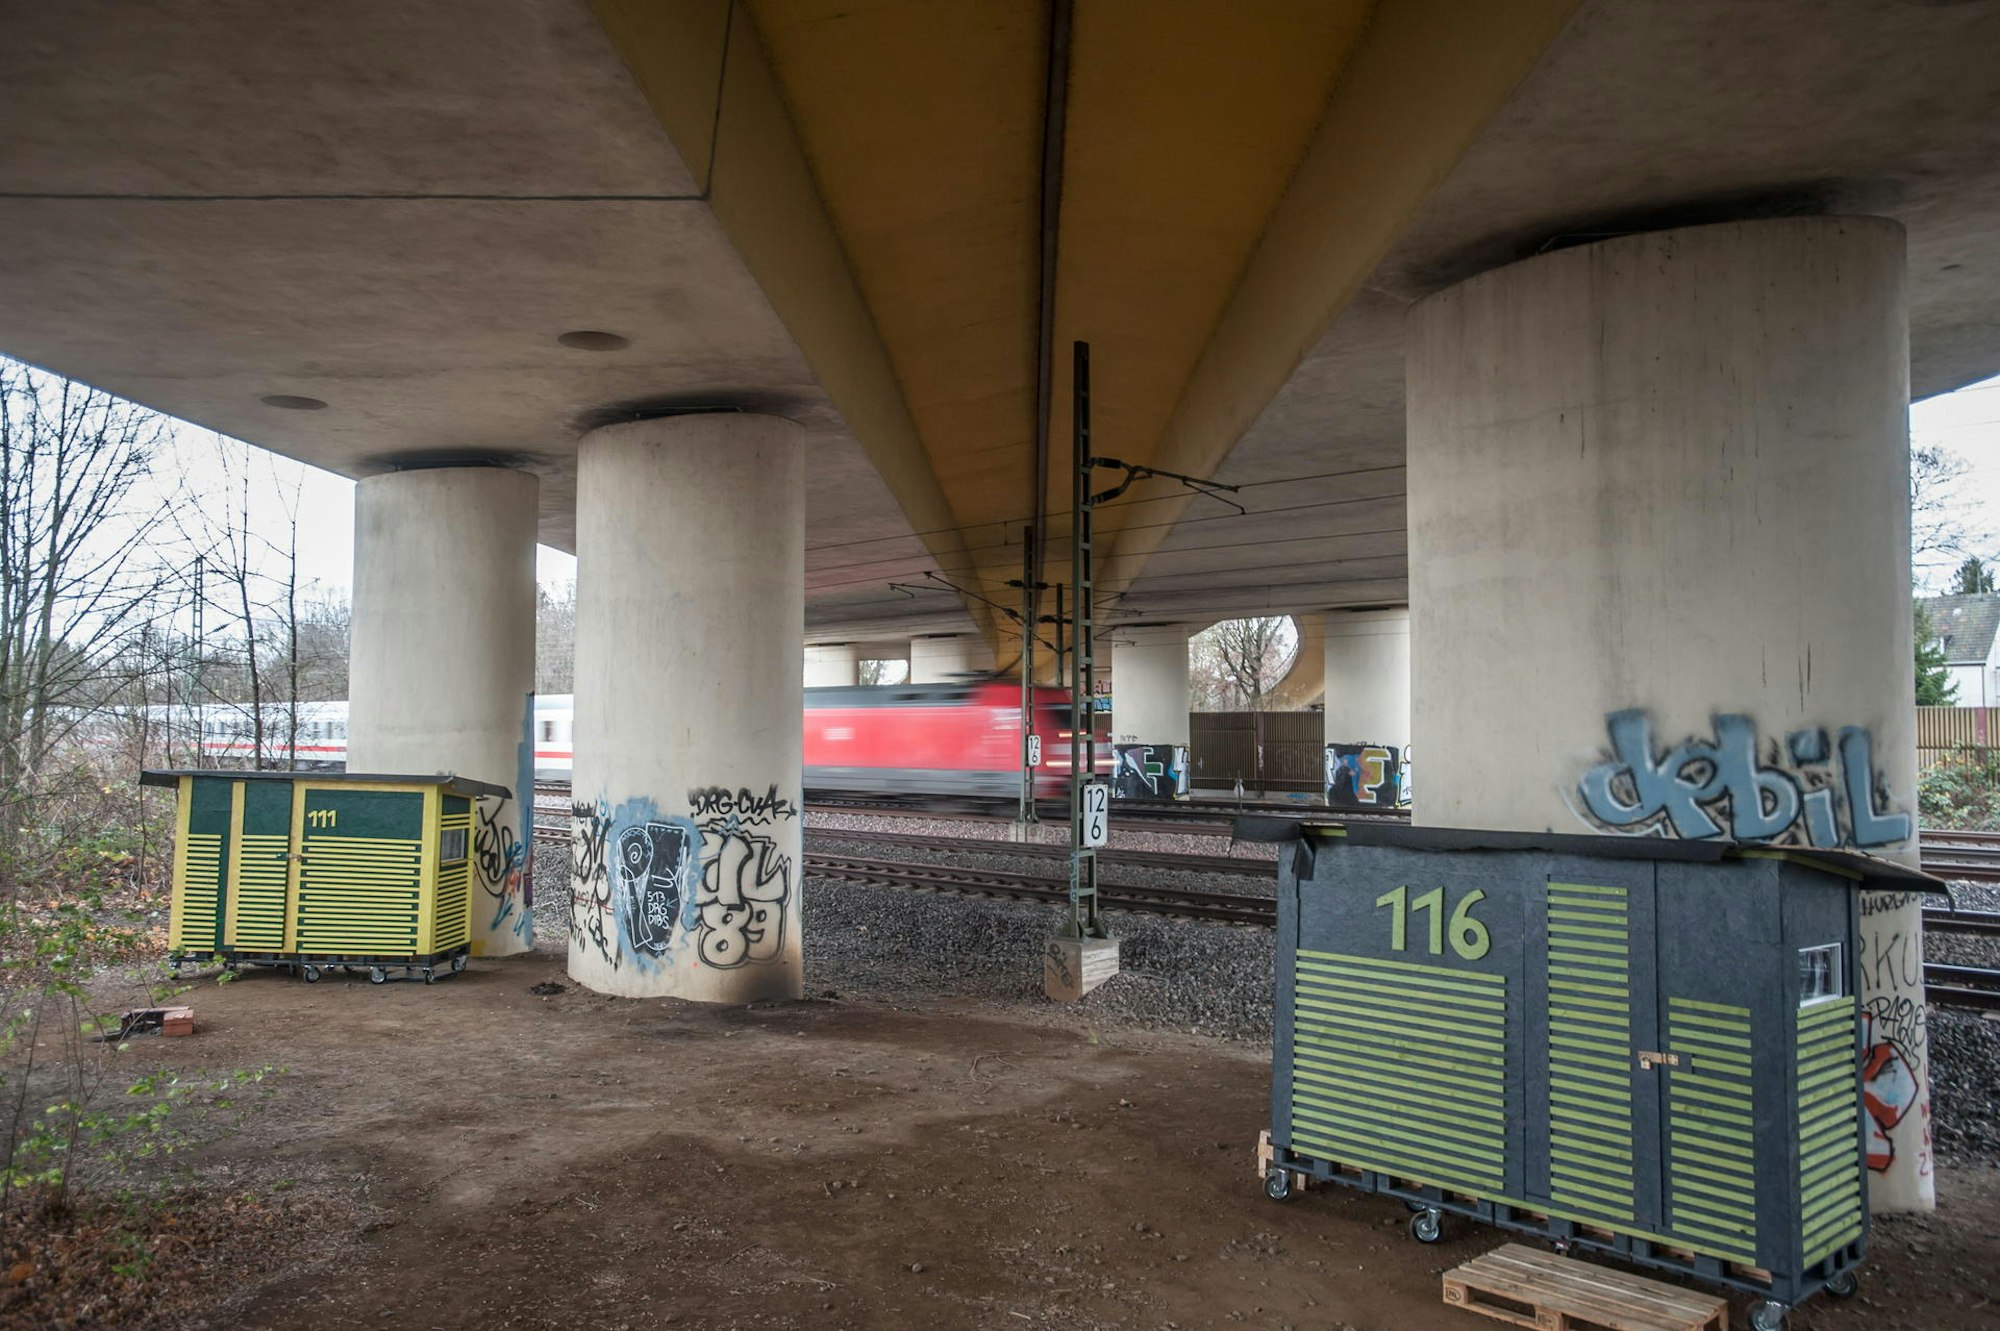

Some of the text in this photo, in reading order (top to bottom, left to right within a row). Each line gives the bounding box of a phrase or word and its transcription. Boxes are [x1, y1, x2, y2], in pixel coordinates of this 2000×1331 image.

[1029, 736, 1040, 750] 12
[1031, 750, 1039, 763] 6
[1086, 787, 1105, 814] 12
[308, 808, 337, 829] 111
[1090, 815, 1102, 840] 6
[1375, 885, 1491, 961] 116
